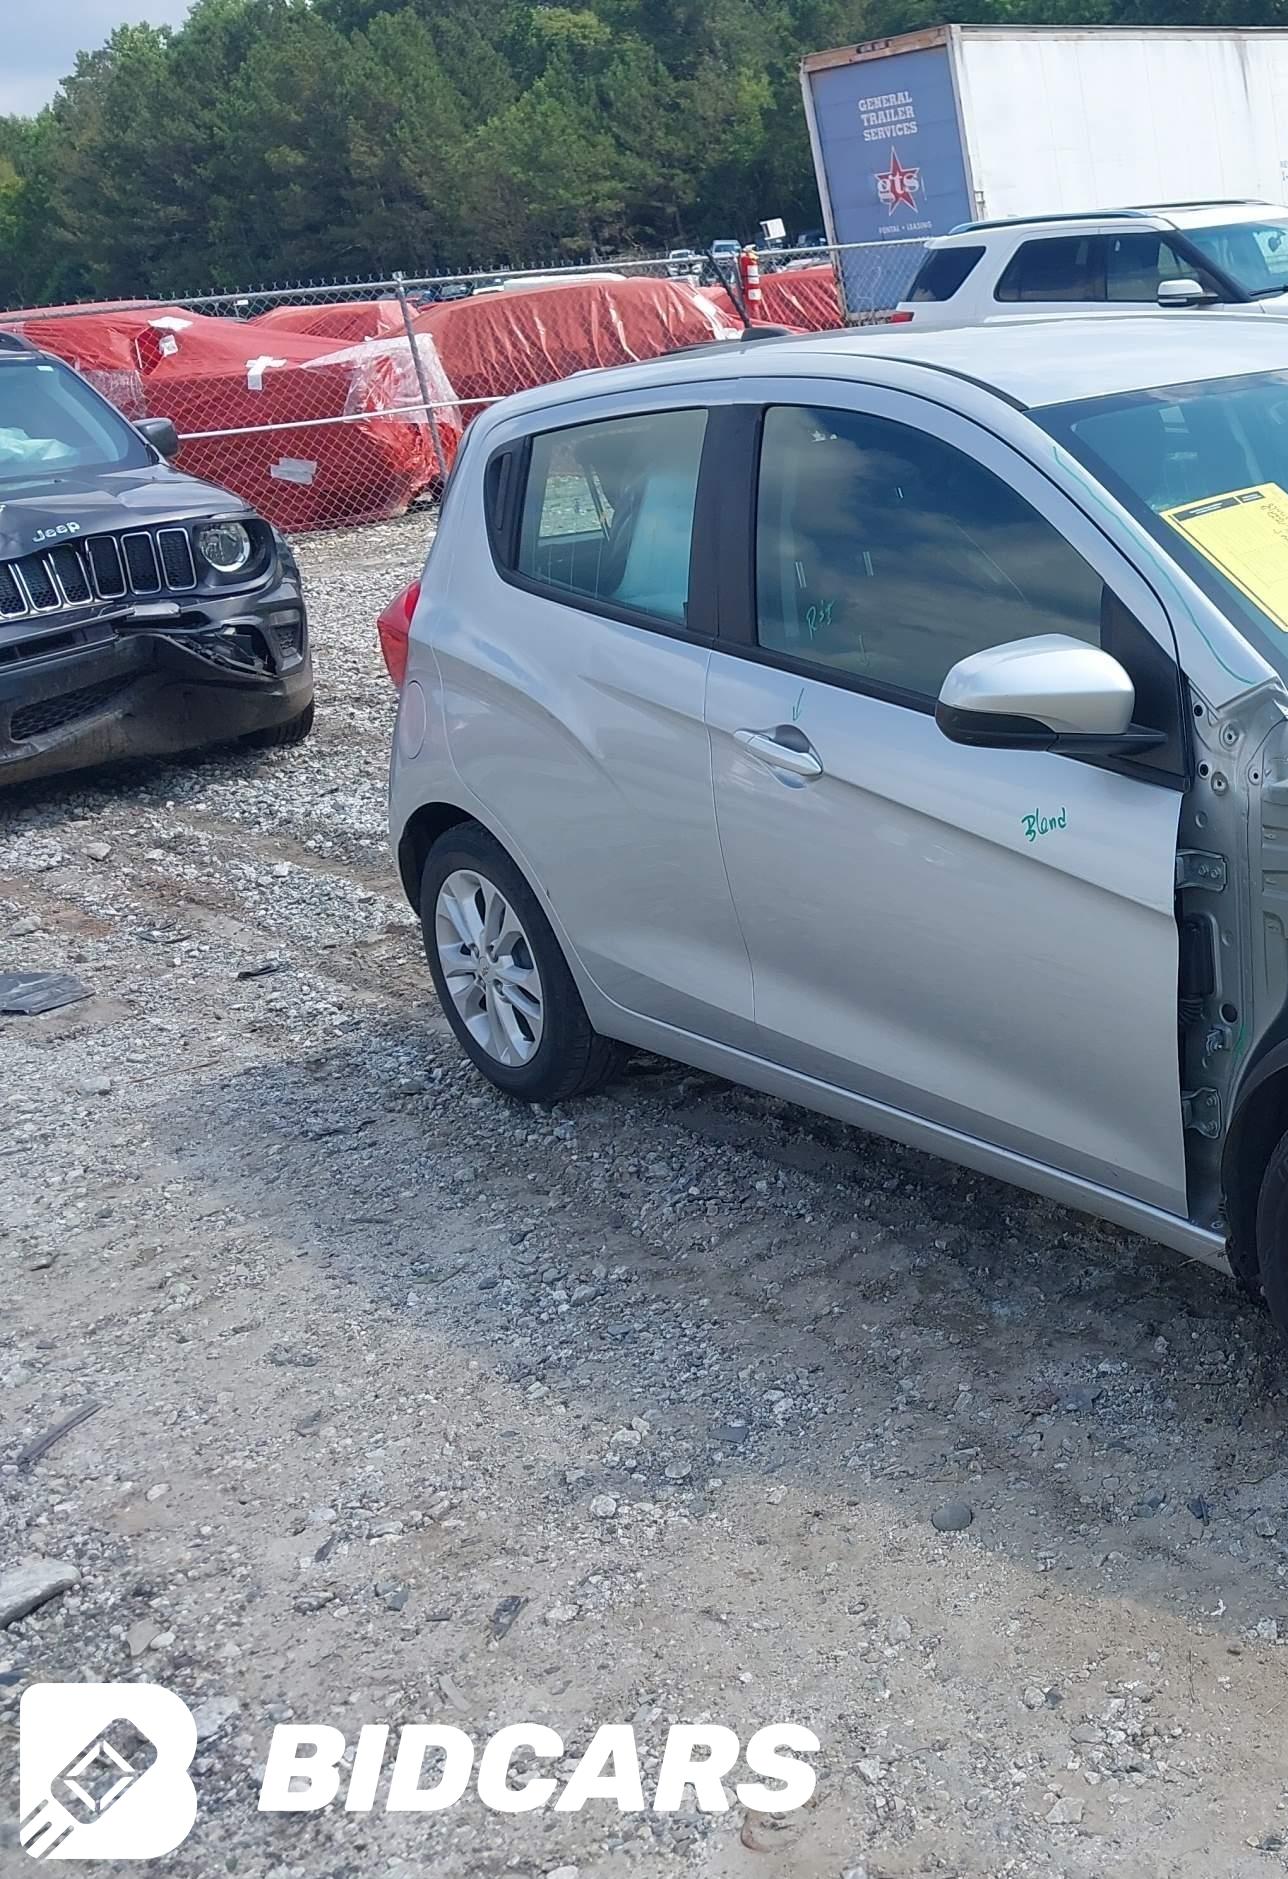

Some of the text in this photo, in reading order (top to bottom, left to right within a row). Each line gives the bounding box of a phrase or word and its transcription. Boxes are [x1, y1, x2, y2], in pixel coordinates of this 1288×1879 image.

[858, 91, 913, 112] GENERAL
[861, 106, 915, 126] TRAILER
[863, 121, 918, 141] SERVICES
[877, 173, 920, 205] gts
[32, 521, 80, 542] Jeep
[1021, 807, 1067, 842] Blend
